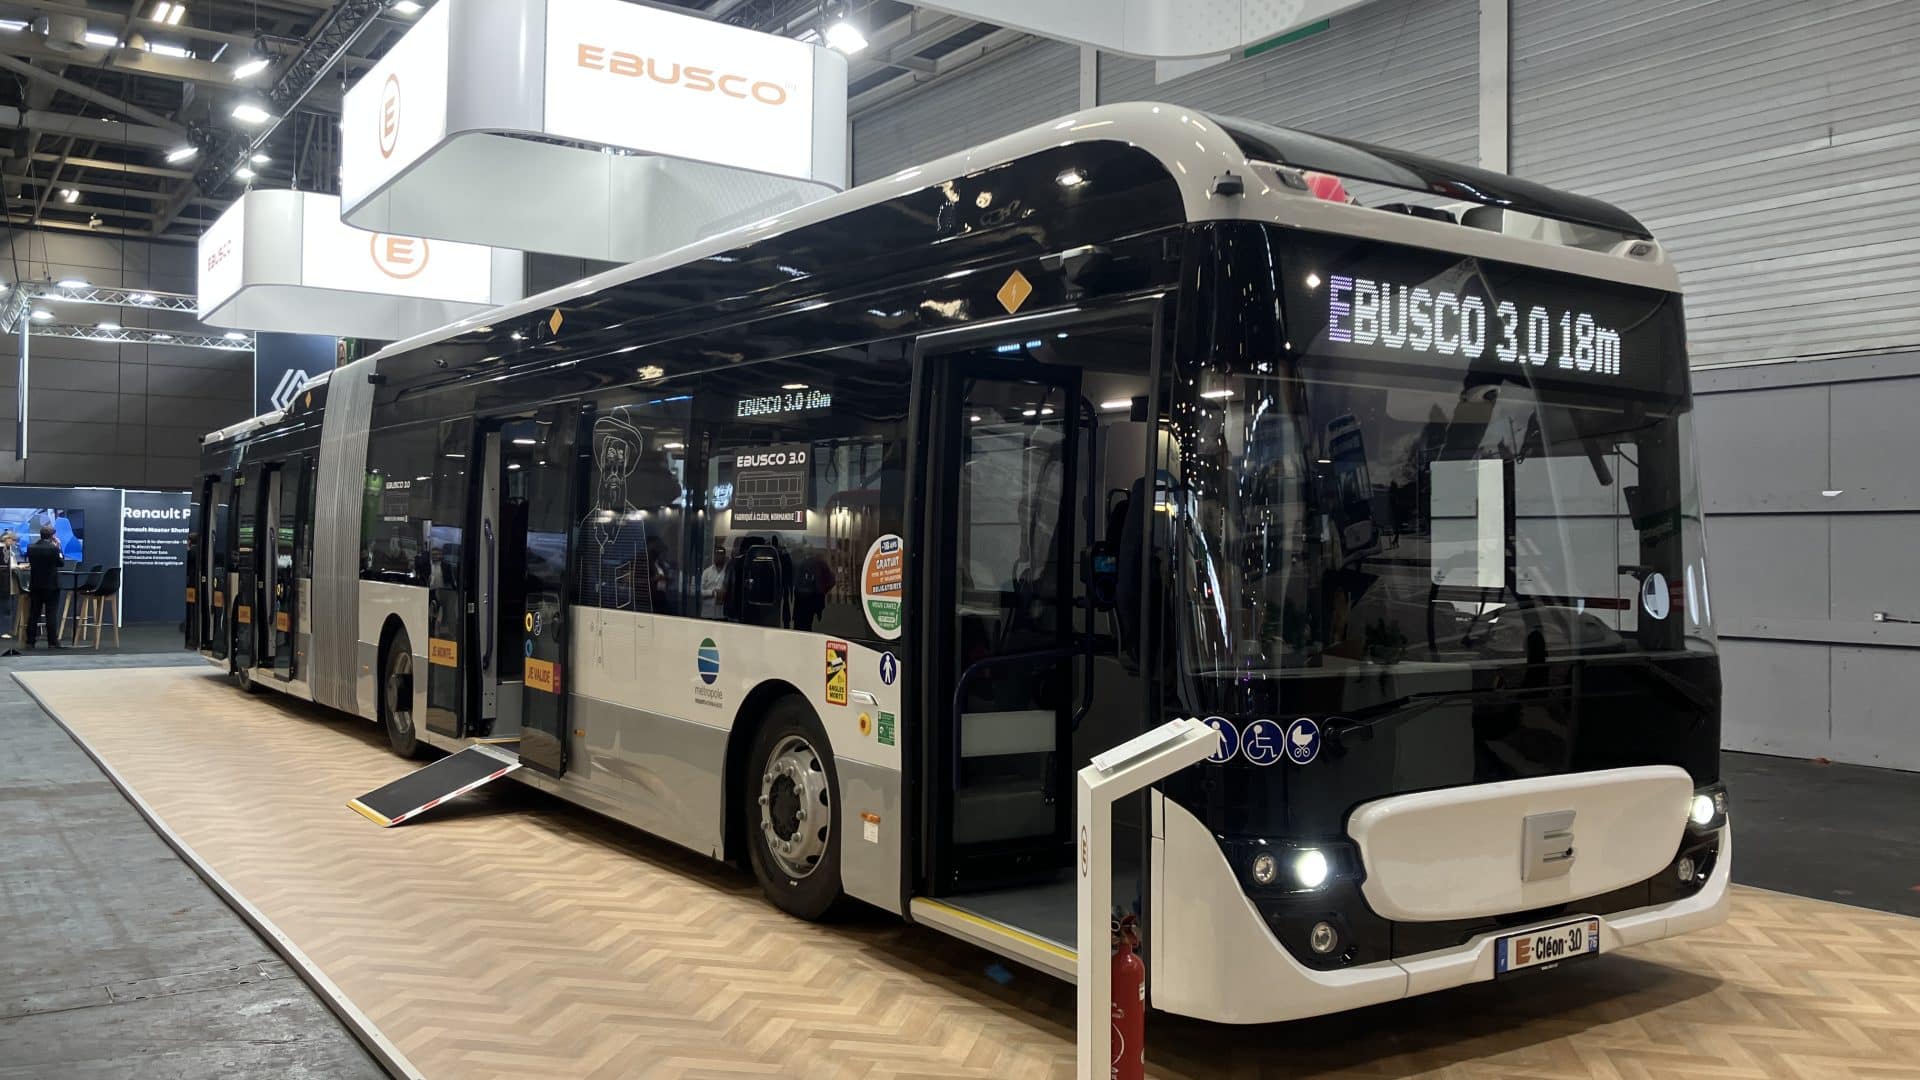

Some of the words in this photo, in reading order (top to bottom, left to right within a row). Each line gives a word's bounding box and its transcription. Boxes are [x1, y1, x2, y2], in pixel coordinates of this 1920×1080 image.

[577, 42, 787, 106] EBUSCO
[207, 239, 232, 272] EBUSCO
[1328, 274, 1487, 359] EBUSCO
[1496, 300, 1551, 367] 3.0
[1558, 309, 1621, 376] 18m
[737, 395, 782, 417] EBUSCO
[783, 392, 804, 412] 3.0
[805, 389, 832, 410] 18m
[736, 452, 786, 468] EBUSCO
[788, 451, 806, 465] 3.0
[123, 507, 181, 519] Renault
